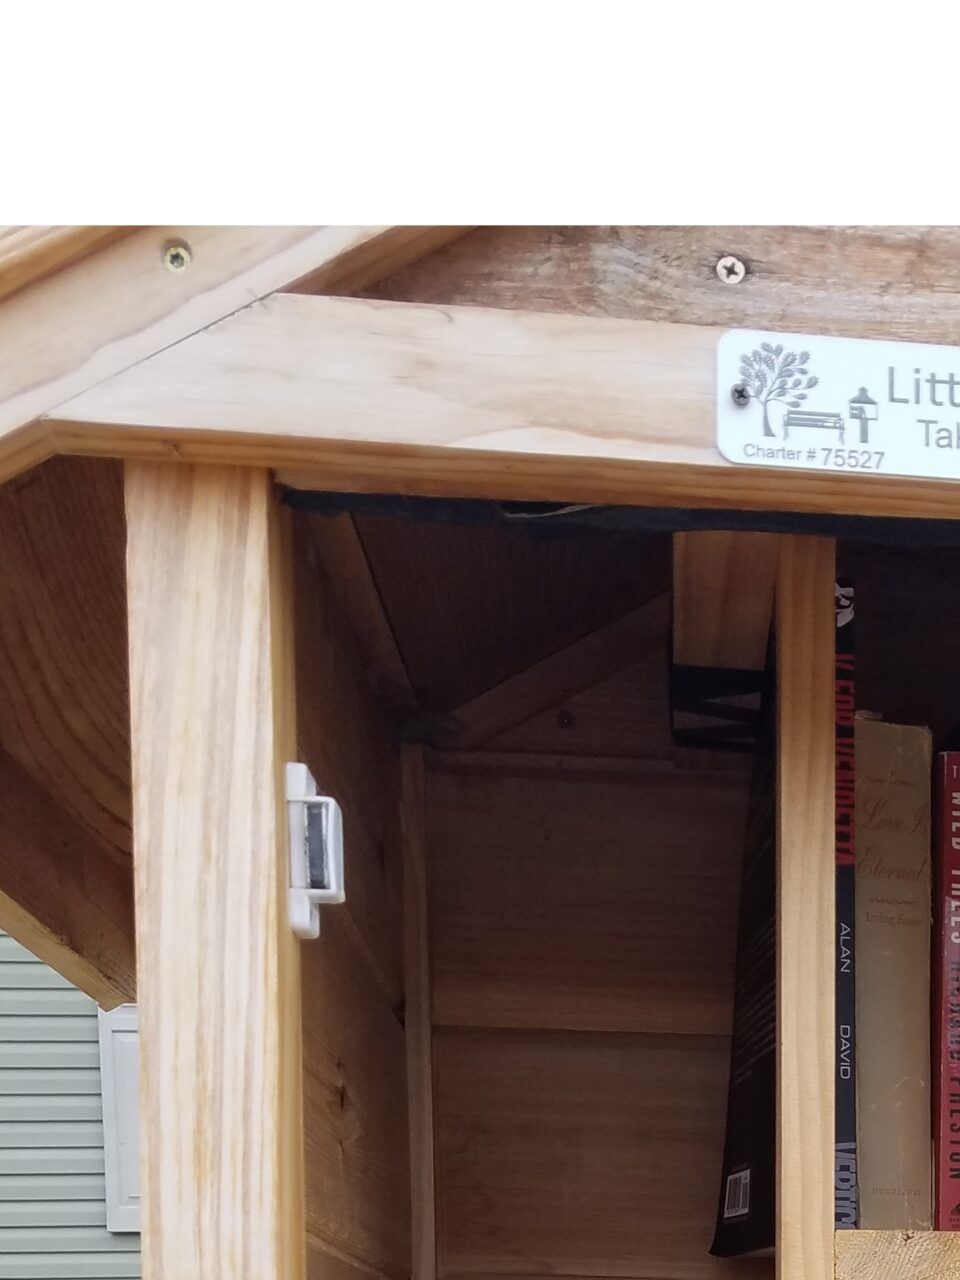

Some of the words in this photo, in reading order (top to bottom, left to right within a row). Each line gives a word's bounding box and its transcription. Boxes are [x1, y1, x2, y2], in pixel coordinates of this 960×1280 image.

[743, 444, 801, 461] Charter
[806, 448, 817, 461] #
[822, 448, 885, 470] 75527
[839, 922, 851, 973] ALAN
[839, 1024, 851, 1080] DAVID
